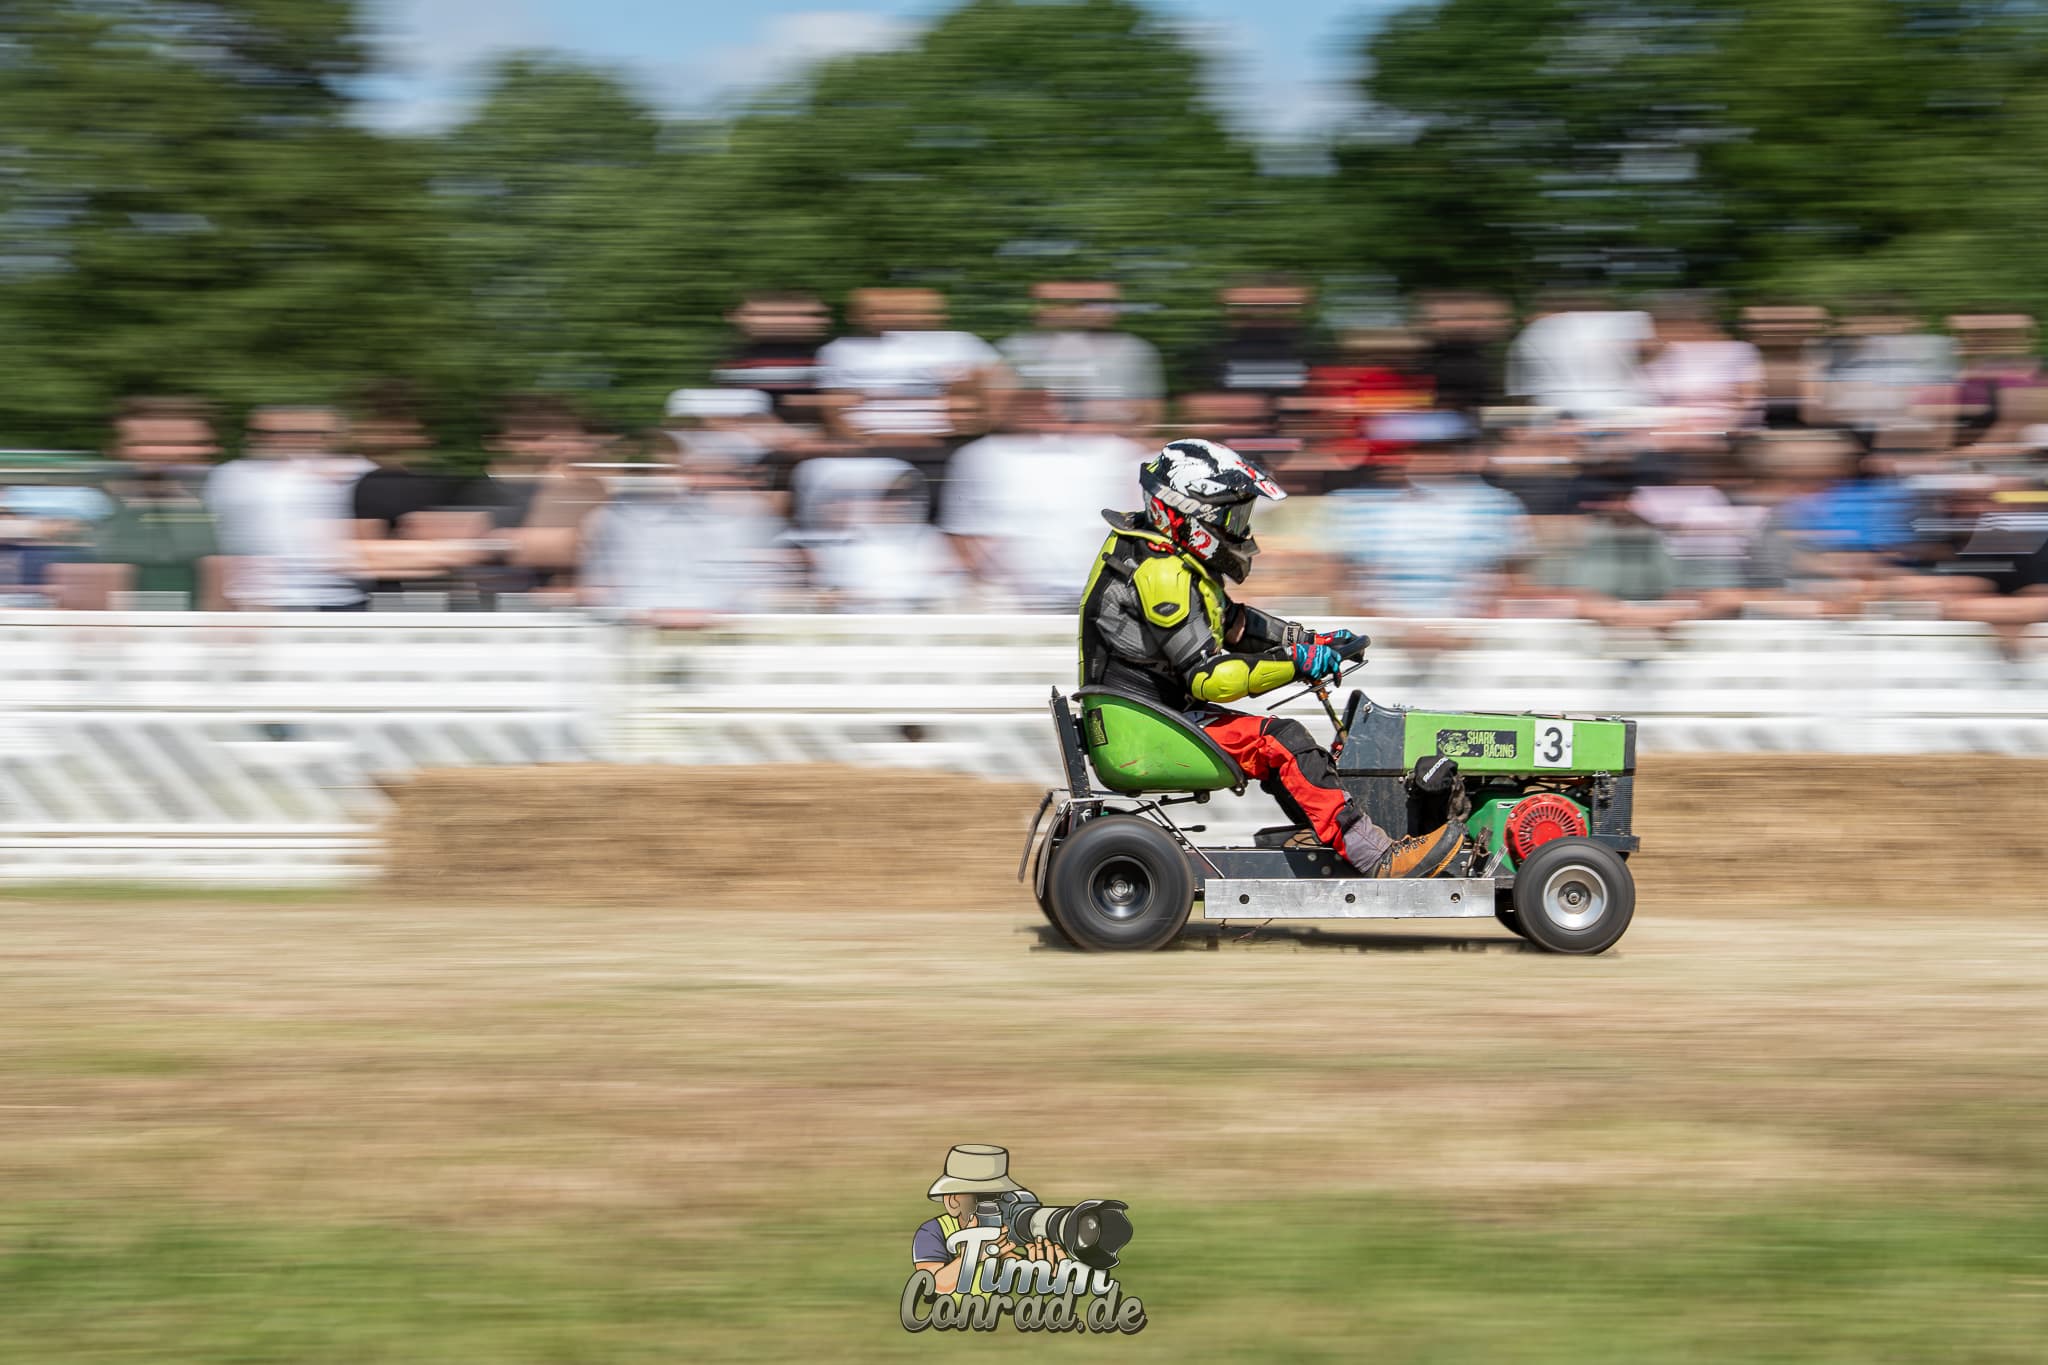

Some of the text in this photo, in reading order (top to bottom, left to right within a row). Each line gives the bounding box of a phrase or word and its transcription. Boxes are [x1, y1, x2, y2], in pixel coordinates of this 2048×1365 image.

[1155, 484, 1221, 523] 100%
[1467, 730, 1496, 744] SHARK
[1544, 727, 1563, 762] 3
[1483, 744, 1514, 757] RACING
